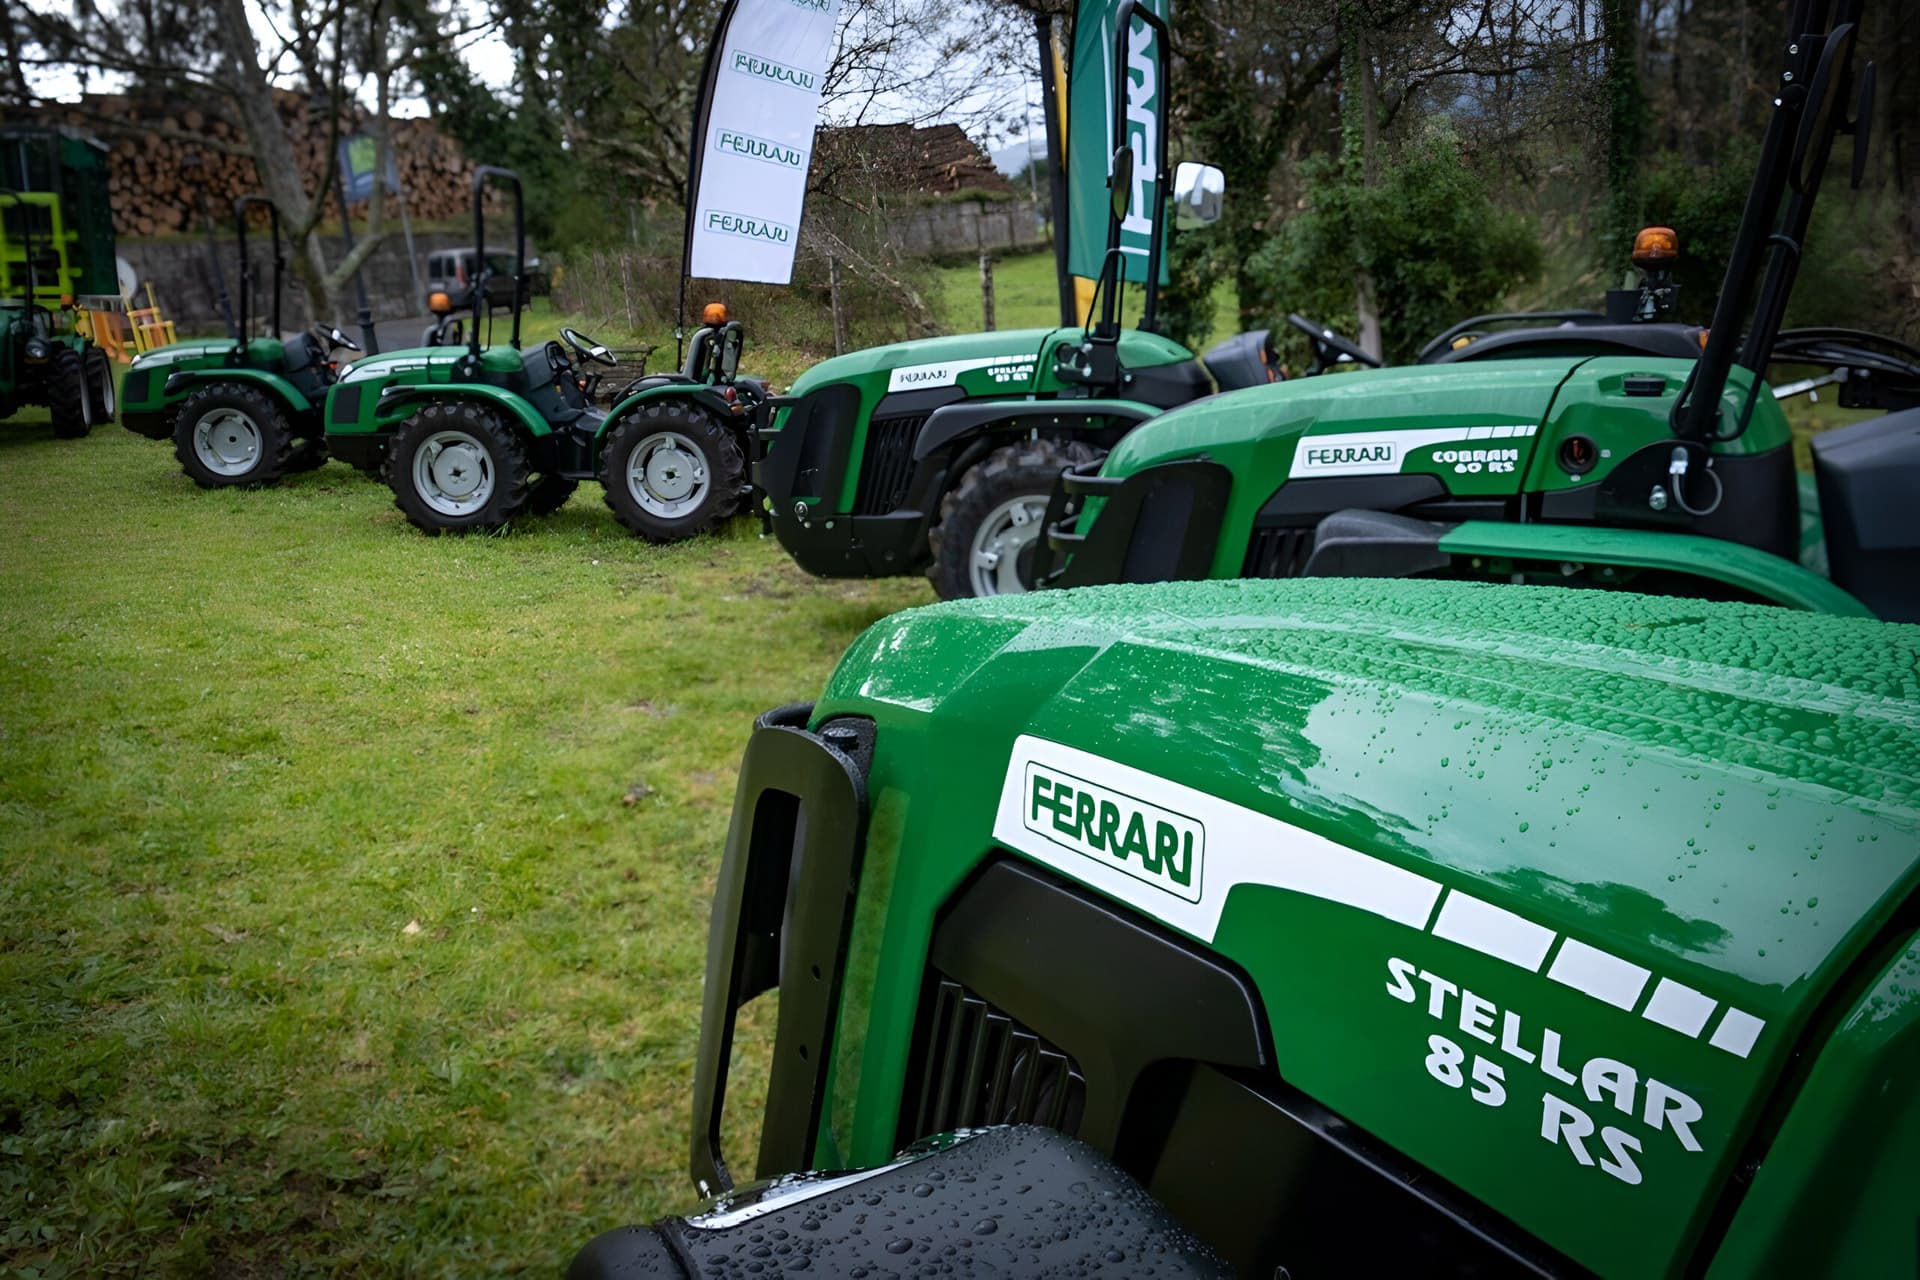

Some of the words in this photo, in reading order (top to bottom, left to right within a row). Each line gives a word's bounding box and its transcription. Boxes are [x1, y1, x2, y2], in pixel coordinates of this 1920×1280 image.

[1308, 446, 1391, 465] FERRARI
[1432, 448, 1518, 463] COBRAM
[1032, 774, 1193, 887] FERRARI
[1386, 957, 1703, 1152] STELLAR
[1425, 1034, 1507, 1107] 85
[1541, 1092, 1643, 1185] RS
